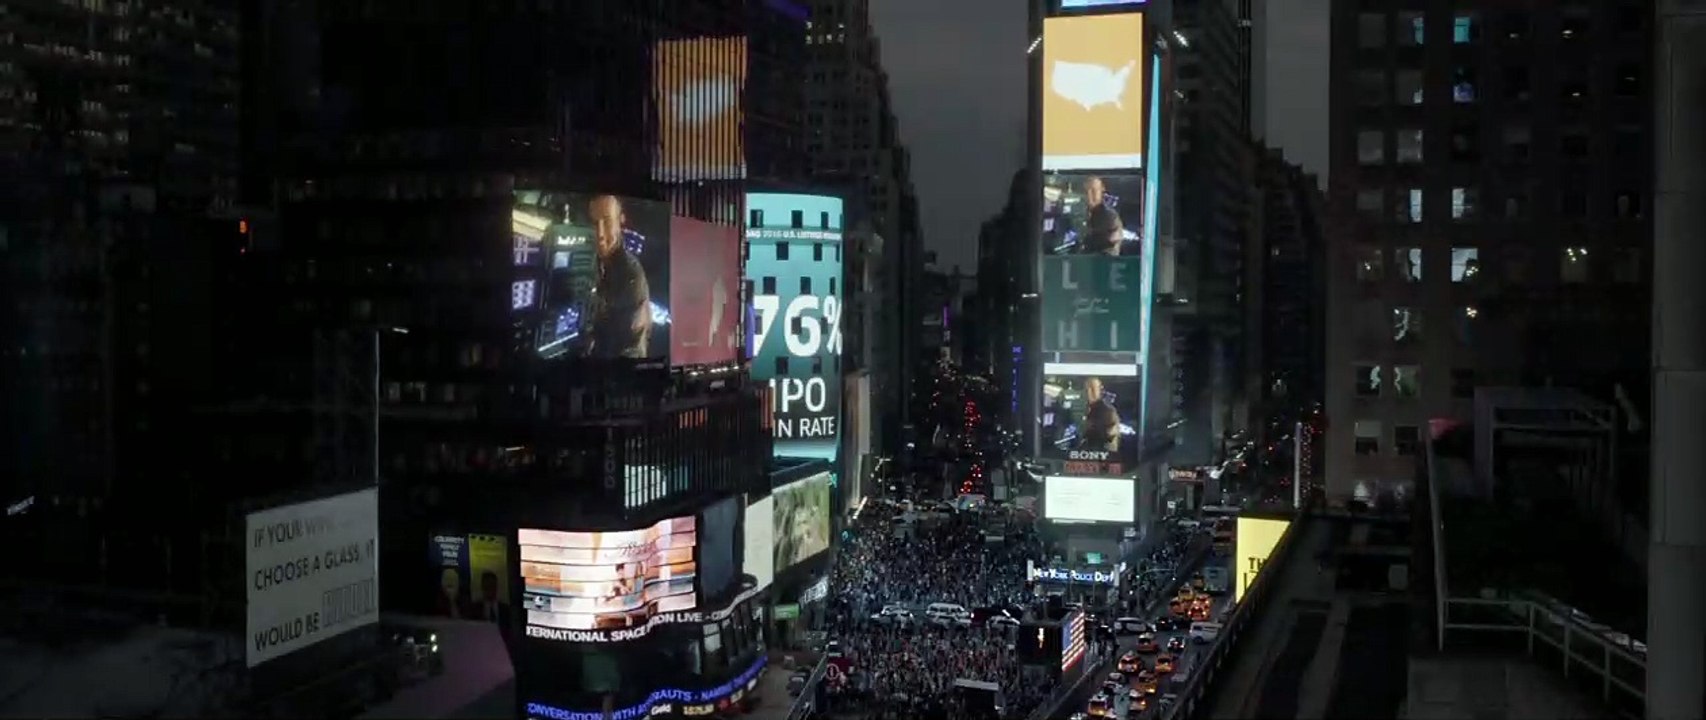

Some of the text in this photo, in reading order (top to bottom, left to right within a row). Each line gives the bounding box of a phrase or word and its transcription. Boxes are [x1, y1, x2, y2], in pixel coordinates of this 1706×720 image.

[1062, 261, 1126, 291] L E
[754, 295, 842, 356] 76%
[769, 378, 826, 413] IPO
[799, 416, 835, 437] RATE
[1069, 450, 1109, 461] SONY
[253, 525, 265, 549] IF
[267, 519, 303, 545] YOUR
[254, 557, 309, 591] CHOOSE
[311, 555, 321, 573] A
[366, 537, 376, 559] IT
[253, 611, 320, 652] WOULD BE
[610, 628, 647, 642] SPACE
[677, 612, 703, 623] LIVE
